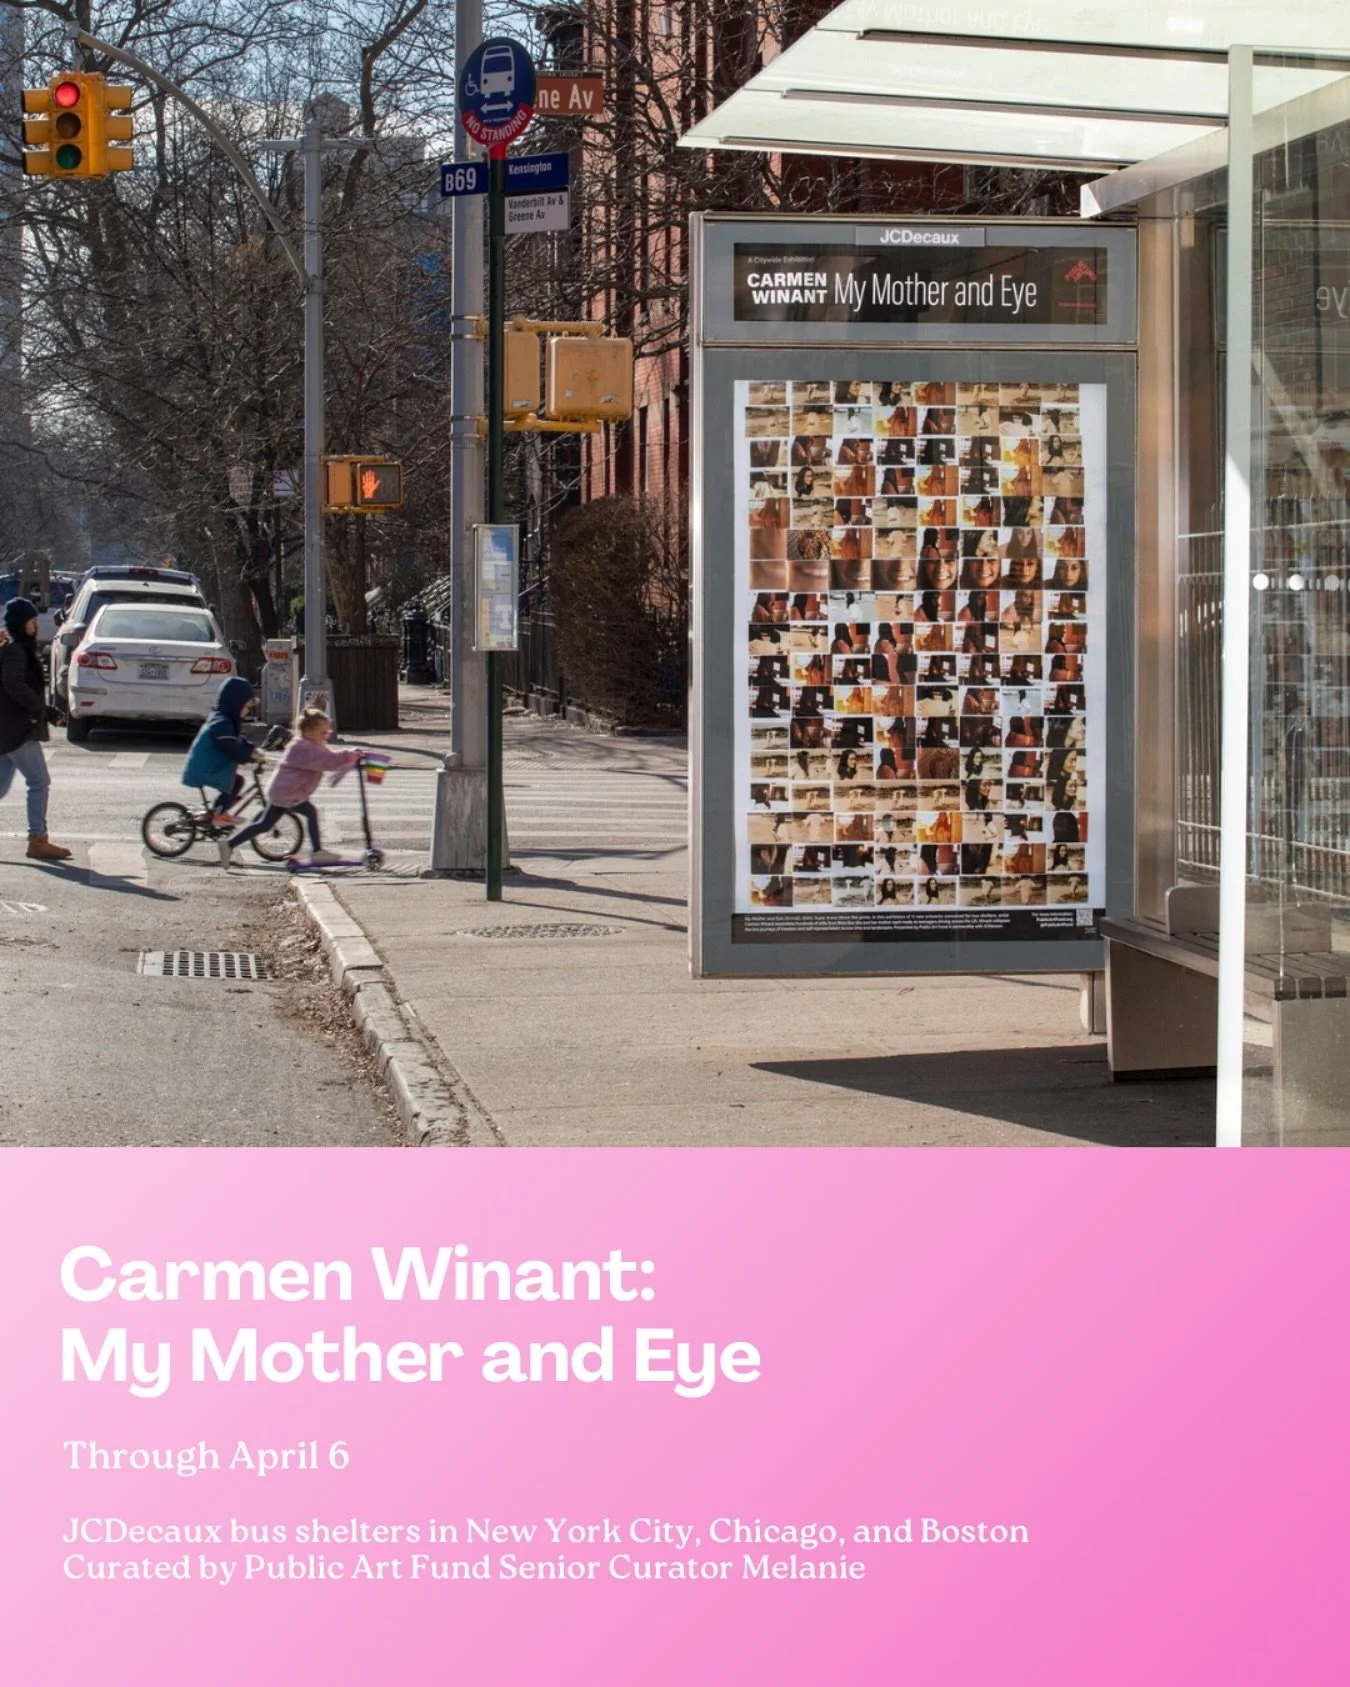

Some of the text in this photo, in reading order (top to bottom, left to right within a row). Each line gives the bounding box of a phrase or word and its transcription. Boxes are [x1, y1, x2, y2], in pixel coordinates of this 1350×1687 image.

[534, 84, 594, 109] ne Av
[466, 109, 527, 141] NO STANDING
[508, 162, 552, 175] Kensington
[445, 168, 477, 192] B69
[508, 198, 545, 209] Vanderbilt
[547, 196, 556, 206] Av
[508, 210, 545, 222] Greene Av
[880, 229, 960, 245] JCDecaux
[754, 256, 782, 264] Citywide
[747, 273, 827, 288] CARMEN
[752, 289, 828, 304] WINANT
[834, 272, 1038, 314] My Mother and Eye
